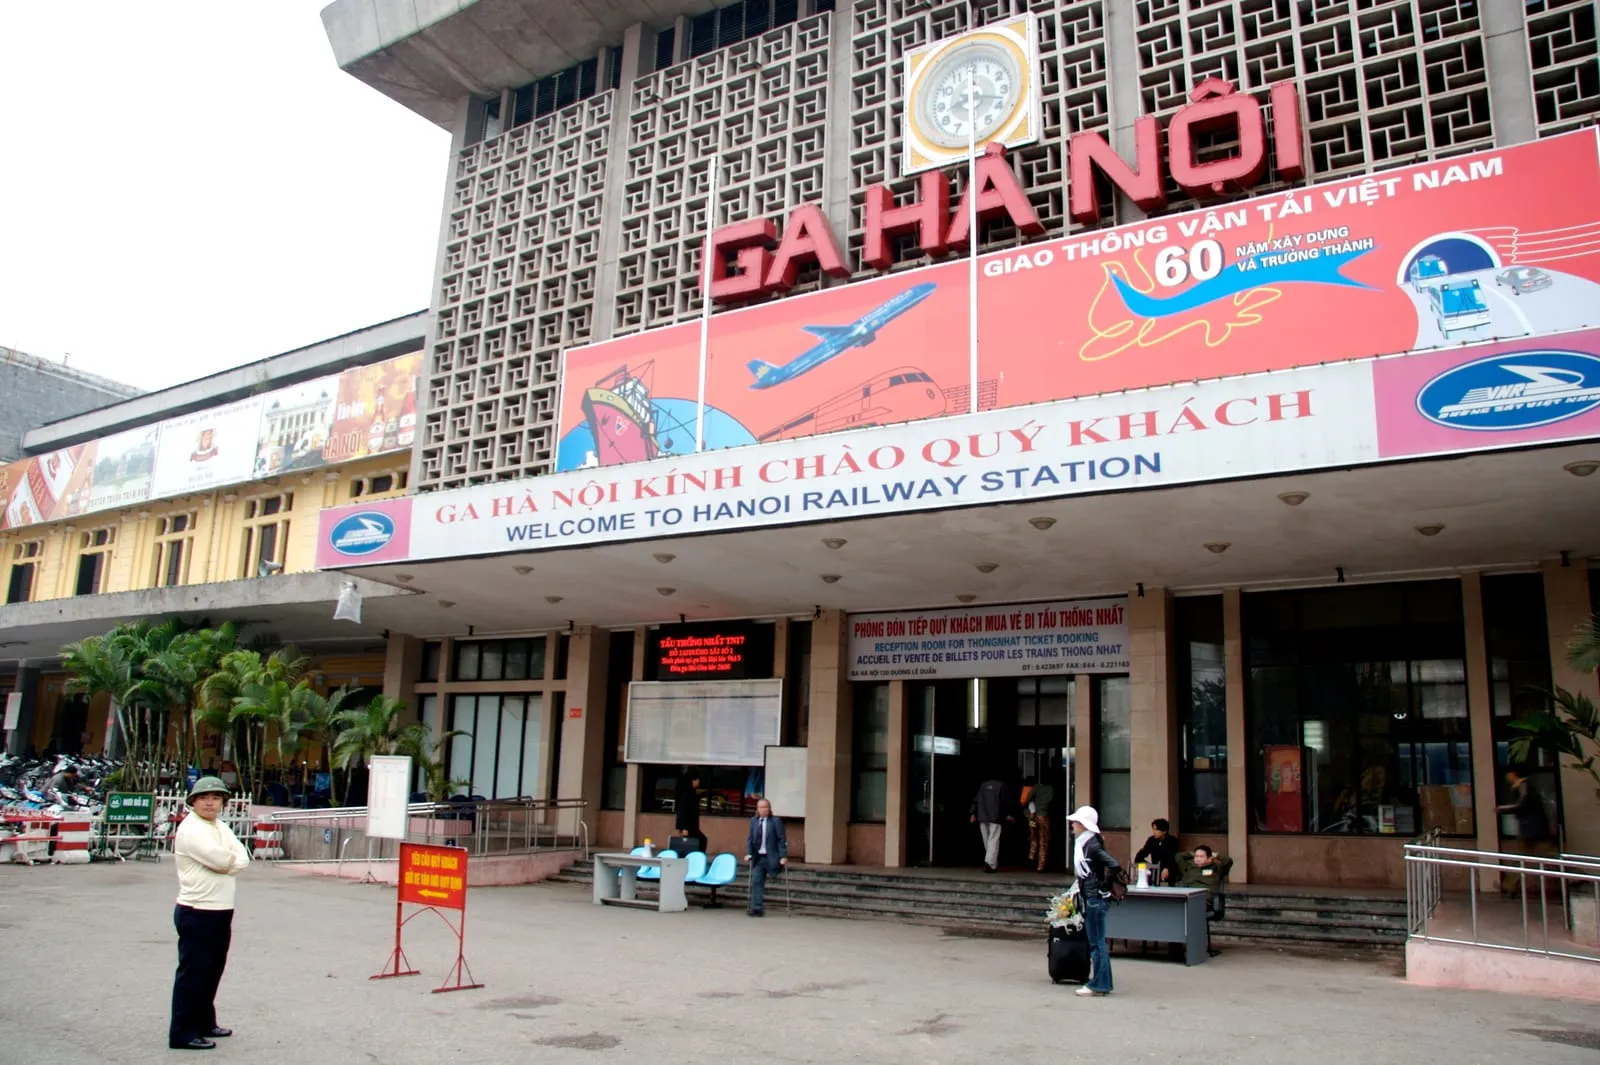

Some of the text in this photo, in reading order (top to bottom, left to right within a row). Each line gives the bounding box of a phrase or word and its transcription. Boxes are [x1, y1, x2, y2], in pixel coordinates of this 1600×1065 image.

[952, 70, 961, 83] 11
[985, 64, 990, 74] 1
[995, 71, 1003, 82] 2
[942, 86, 954, 97] 10
[1000, 84, 1008, 94] 3
[937, 102, 946, 113] 9
[994, 100, 1004, 110] 4
[942, 115, 951, 126] 8
[954, 123, 962, 133] 7
[984, 114, 993, 125] 5
[701, 77, 1305, 304] GA HÀ NỘI
[983, 157, 1504, 277] GIAO THÔNG VẬN TẢI VIỆT NAM
[1236, 226, 1349, 257] NĂM XÂY DỰNG
[1154, 239, 1225, 287] 60
[1236, 238, 1374, 273] VÀ TRƯỞNG THÀNH
[1486, 383, 1526, 400] VNR
[435, 389, 1316, 525] GA HÀ NỘI KÍNH CHÀO QUÝ KHÁCH
[506, 452, 1161, 543] WELCOME TO HANOI RAILWAY STATION
[854, 618, 884, 638] PHÒNG
[887, 616, 905, 637] ĐÓN
[908, 615, 928, 636] TIẾP
[930, 614, 947, 636] QUÝ
[950, 613, 982, 633] KHÁCH
[985, 614, 1007, 632] MUA
[1059, 605, 1093, 627] THỐNG
[1096, 603, 1124, 625] NHẤT
[875, 632, 1099, 652] RECEPTION ROOM FOR THONGNHAT TICKET BOOKING
[857, 644, 1122, 664] ACCUEIL ET VENTE DE BILLETS POUR LES TRAINS THONG NHAT
